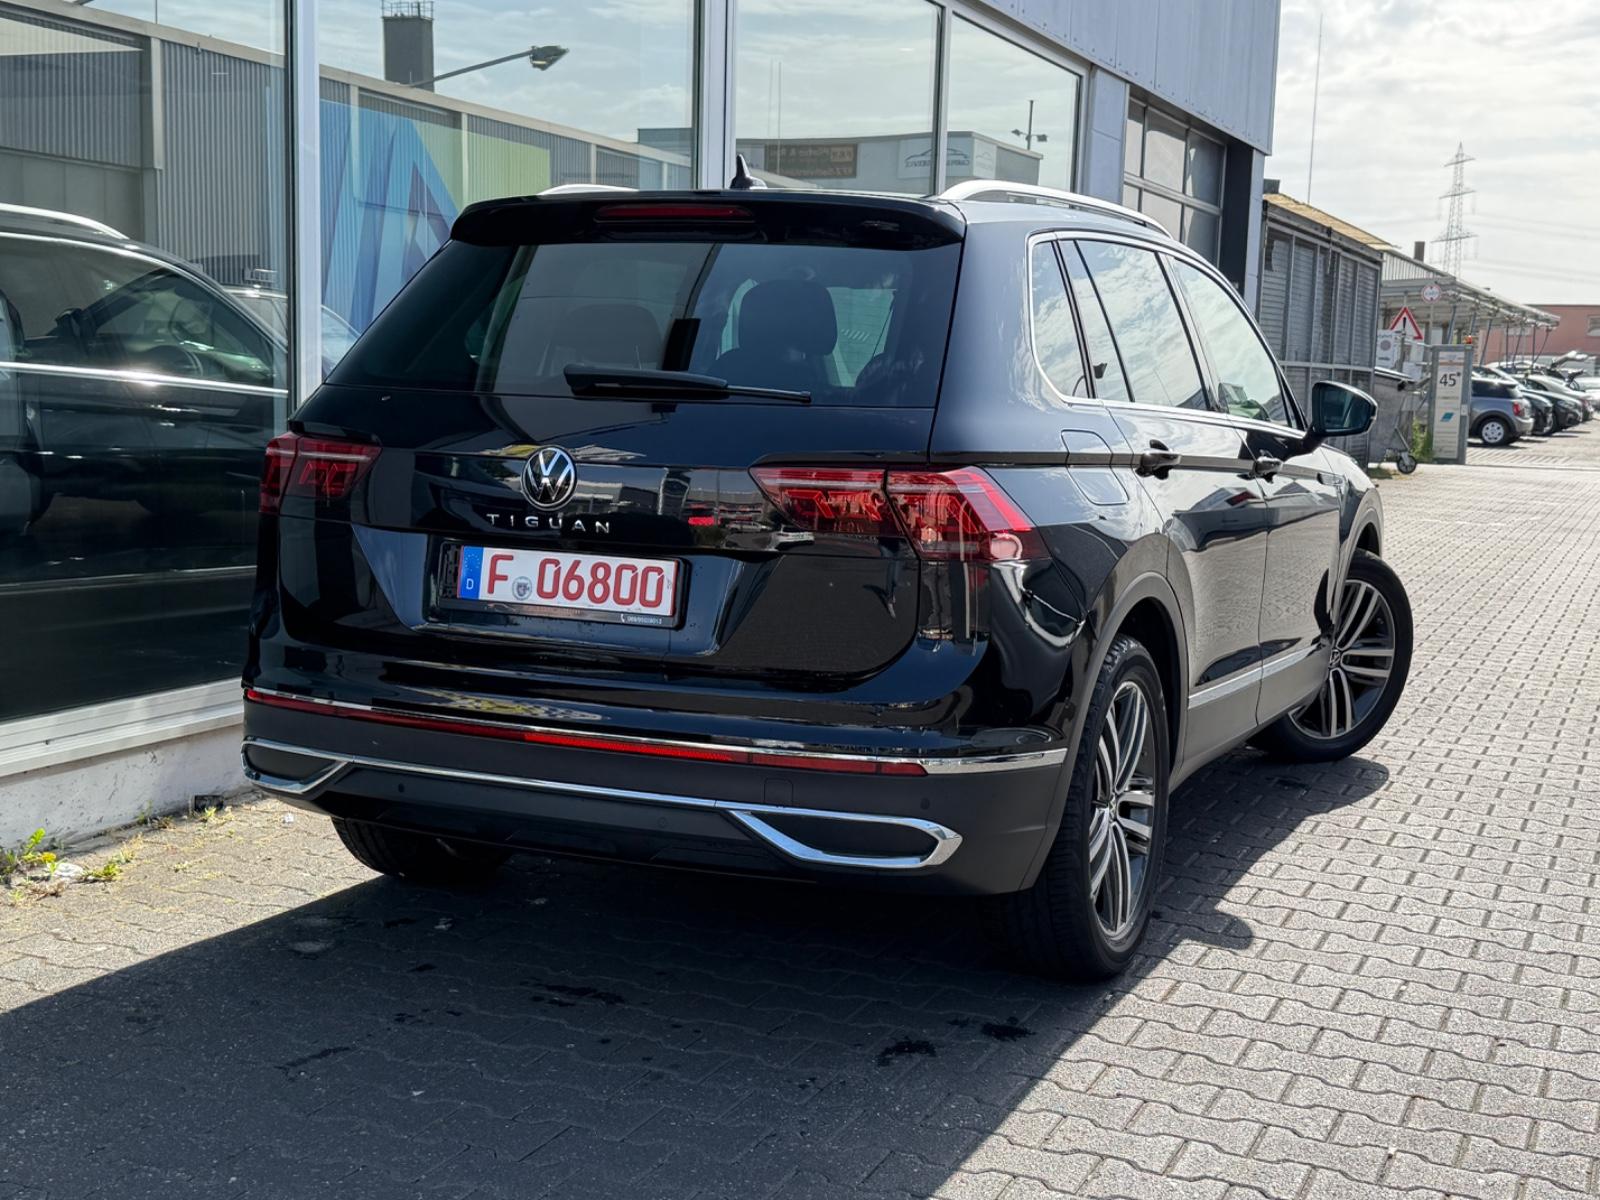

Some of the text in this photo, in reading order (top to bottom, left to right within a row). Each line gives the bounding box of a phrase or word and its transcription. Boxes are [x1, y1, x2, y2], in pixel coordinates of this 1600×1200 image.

[486, 513, 610, 534] TIGUAN
[466, 554, 665, 609] D F 06800
